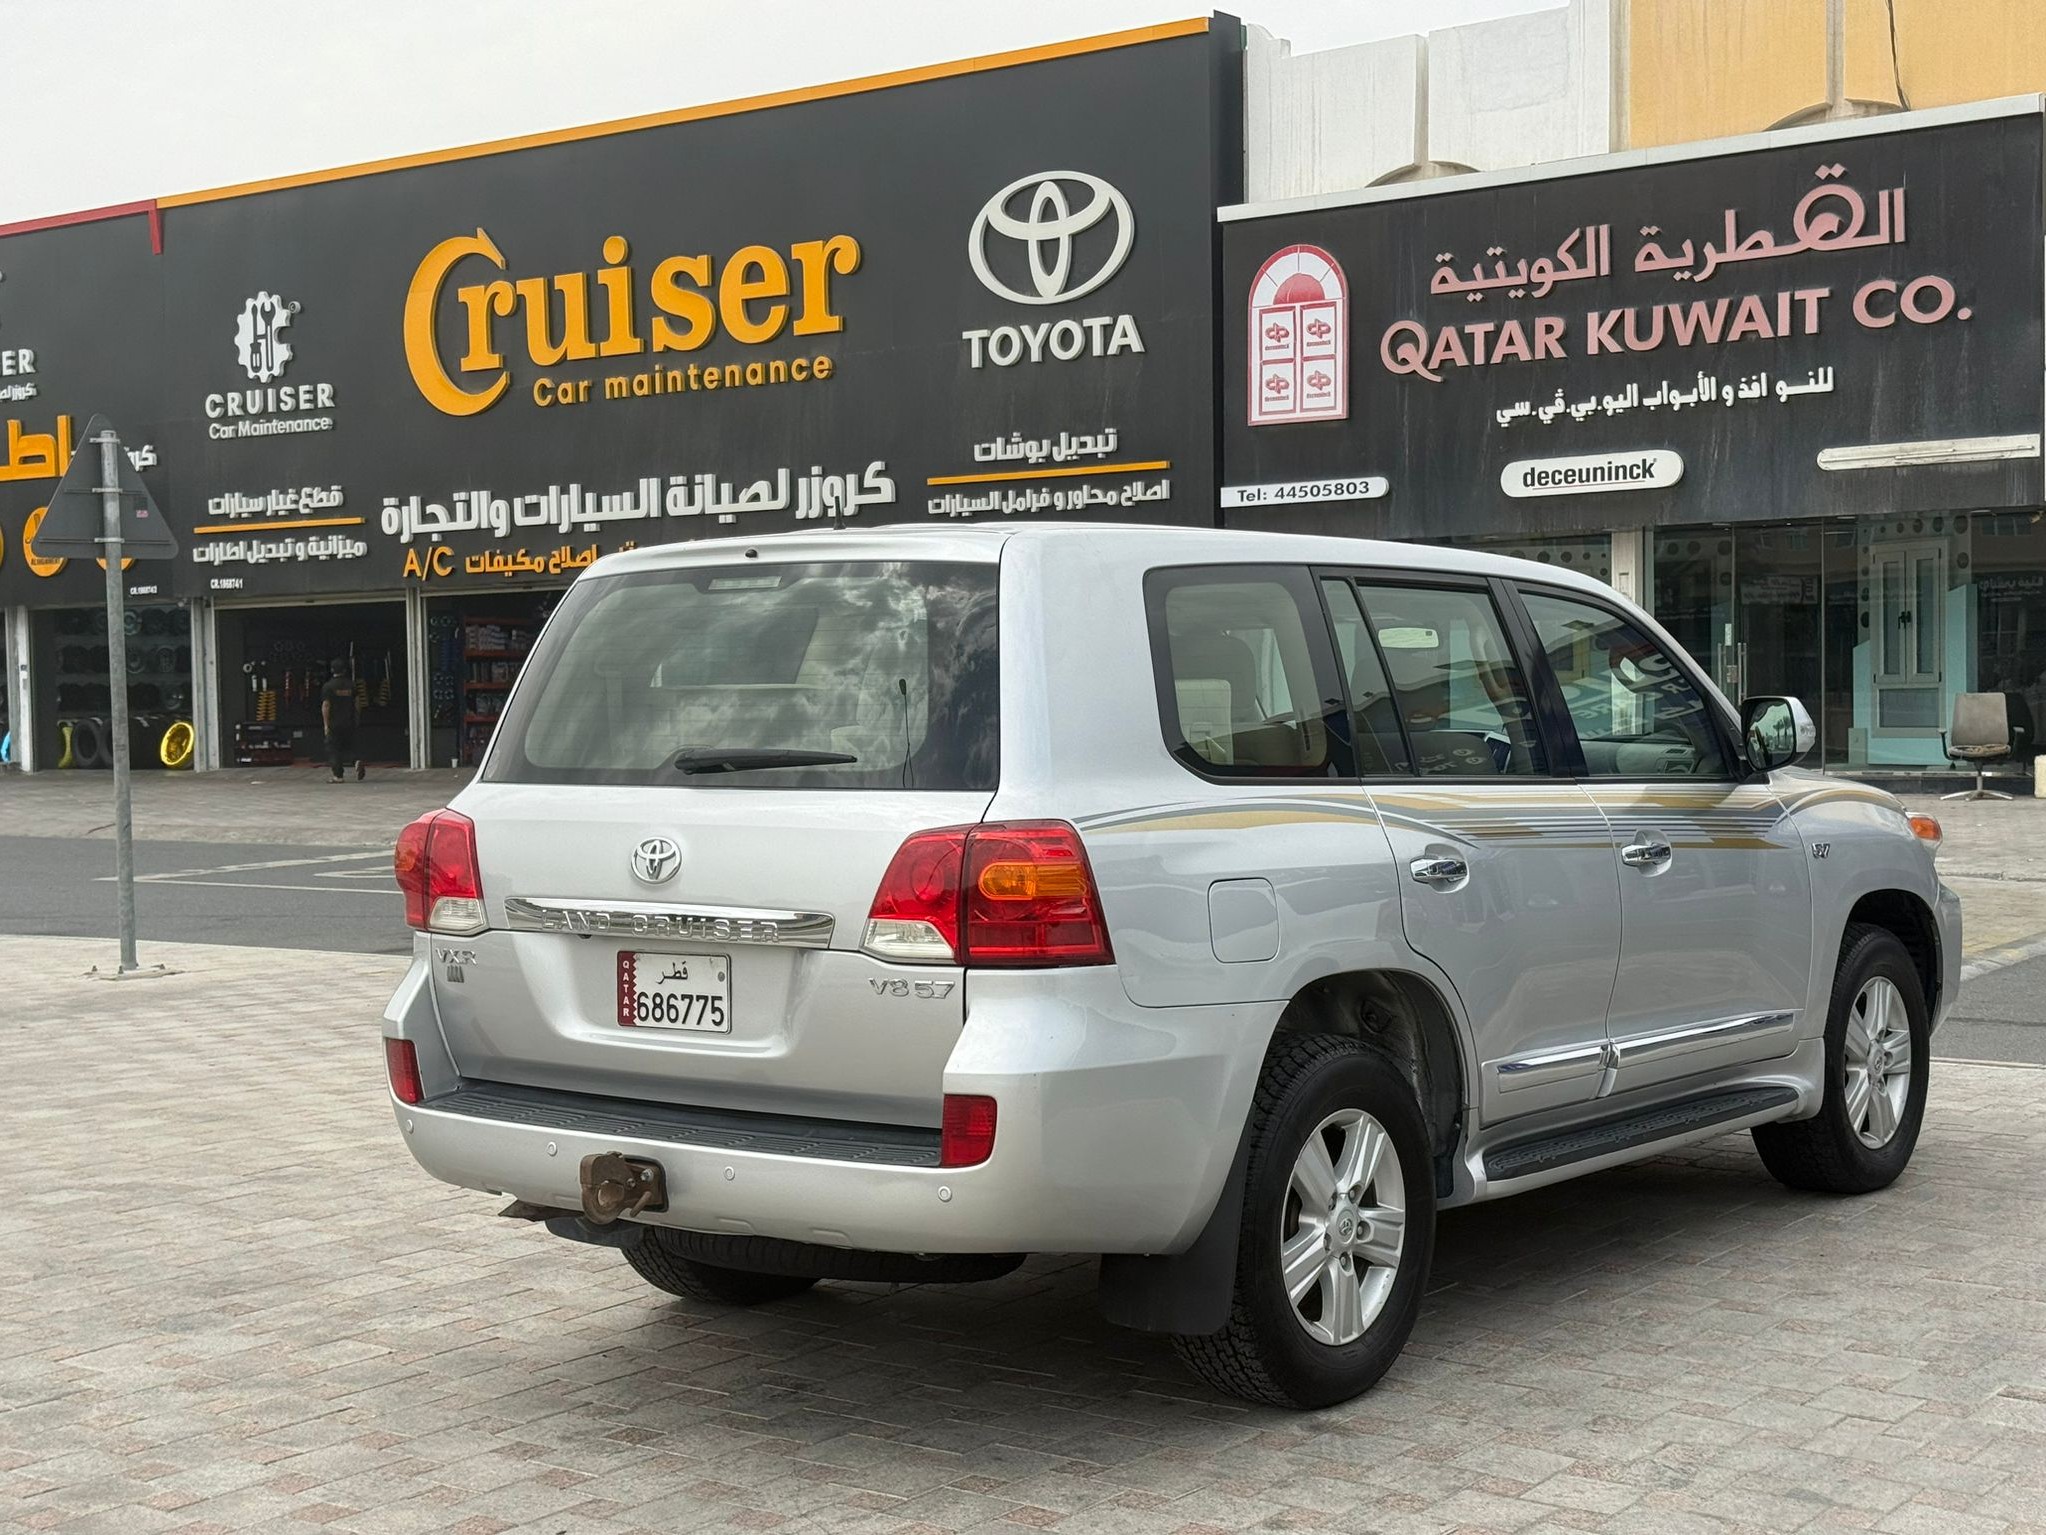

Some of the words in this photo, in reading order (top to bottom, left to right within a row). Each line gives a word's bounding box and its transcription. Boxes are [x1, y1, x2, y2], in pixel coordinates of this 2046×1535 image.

[1634, 163, 1906, 282] القطرية
[1430, 223, 1612, 302] الكويتية
[403, 227, 862, 417] Cruiser
[1380, 315, 1568, 383] QATAR
[1585, 287, 1831, 354] KUWAIT
[1852, 274, 1972, 328] CO.
[962, 314, 1145, 368] TOYOTA
[1, 349, 36, 376] ER
[533, 377, 591, 407] Car
[605, 355, 834, 400] maintenance
[205, 383, 335, 418] CRUISER
[209, 422, 237, 440] Car
[238, 417, 333, 437] Maintenance
[1052, 428, 1118, 461] تبديل
[974, 432, 1051, 463] بوشات
[796, 460, 896, 519] كروزر
[1522, 458, 1656, 488] deceuninck
[208, 492, 266, 518] سيارات
[266, 488, 300, 516] غيار
[299, 485, 344, 514] قطع
[513, 477, 661, 534] السيارات
[666, 468, 790, 524] لصيانة
[928, 490, 1002, 517] السيارات
[1237, 488, 1267, 502] Tel:
[1274, 481, 1369, 499] 44505803
[381, 490, 511, 544] والتجارة
[193, 541, 247, 566] اطارات
[308, 535, 367, 560] ميزانية
[402, 546, 454, 581] A/C
[465, 549, 546, 577] مكيفات
[542, 908, 611, 931] LAND
[630, 914, 779, 944] CRUISER
[622, 960, 630, 1017] QATAR
[655, 961, 689, 985] قطر
[868, 977, 910, 998] V8
[636, 991, 725, 1027] 686775
